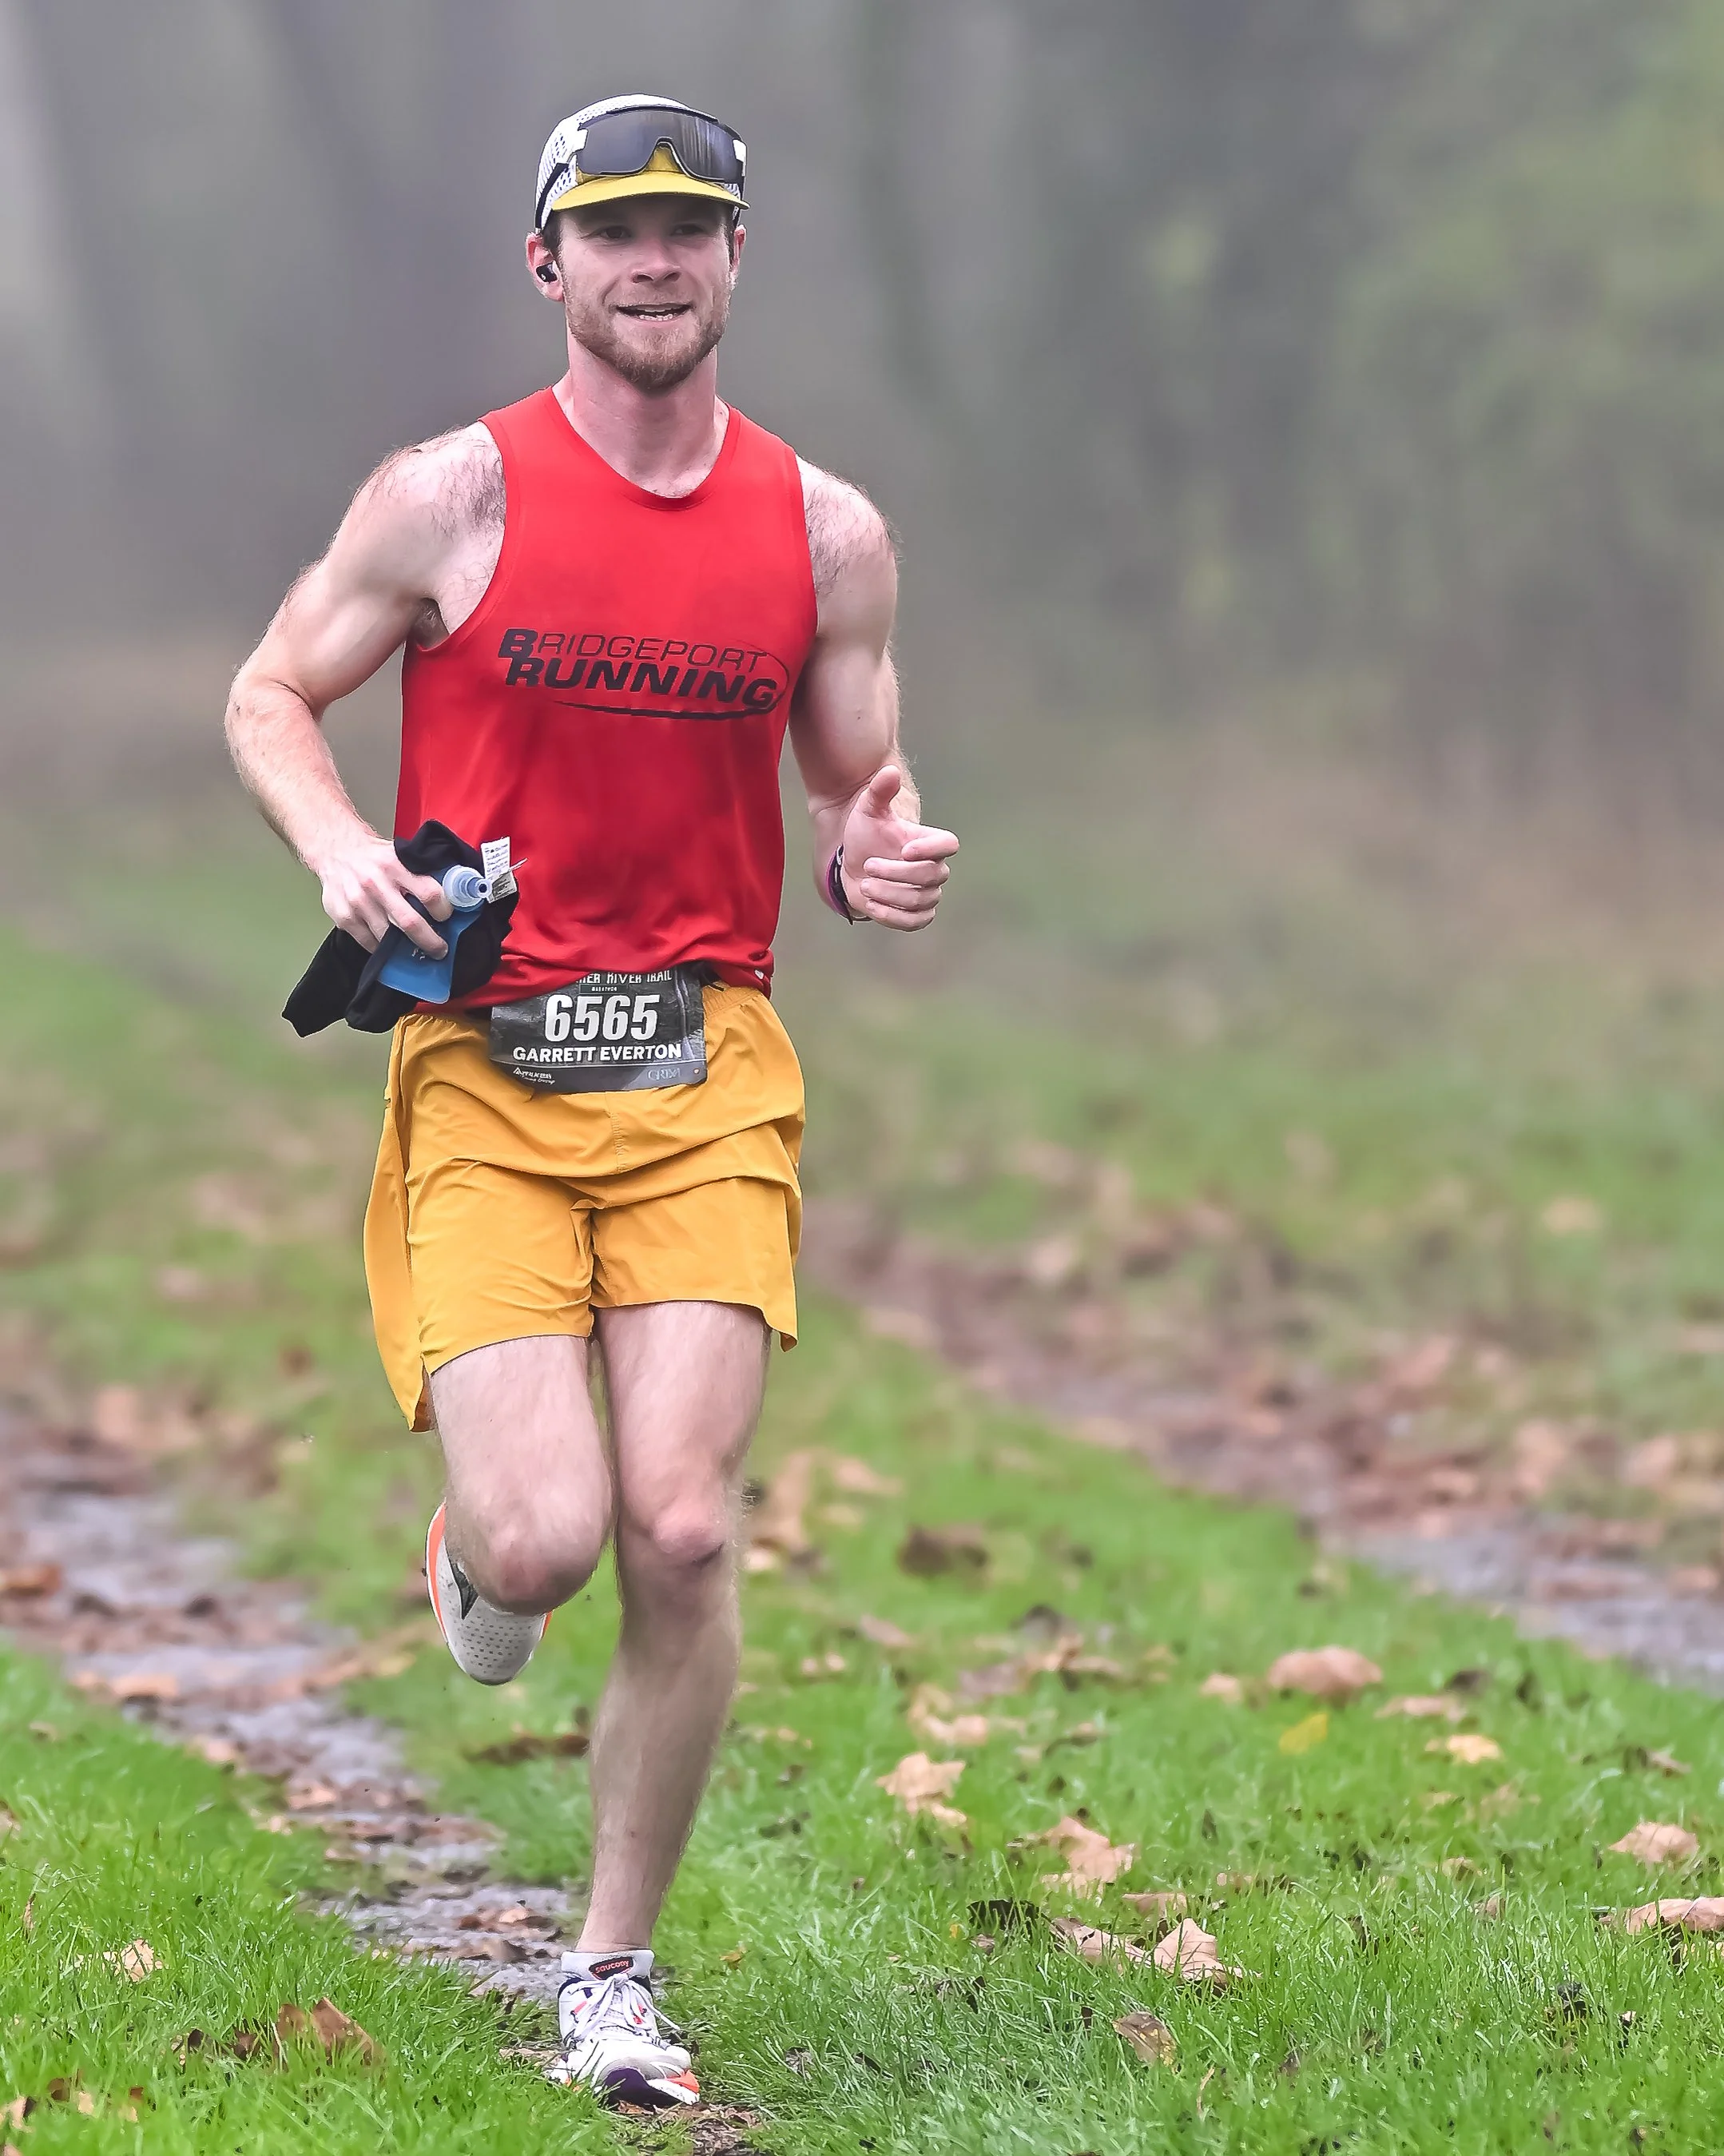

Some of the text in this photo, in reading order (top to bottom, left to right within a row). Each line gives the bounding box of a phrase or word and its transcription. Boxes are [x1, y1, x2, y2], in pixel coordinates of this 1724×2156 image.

[498, 628, 767, 672] BRIDGEPORT
[505, 657, 778, 708] RUNNING
[606, 972, 642, 984] RIVER
[544, 994, 660, 1042] 6565
[512, 1043, 682, 1062] GARRETT EVERTON
